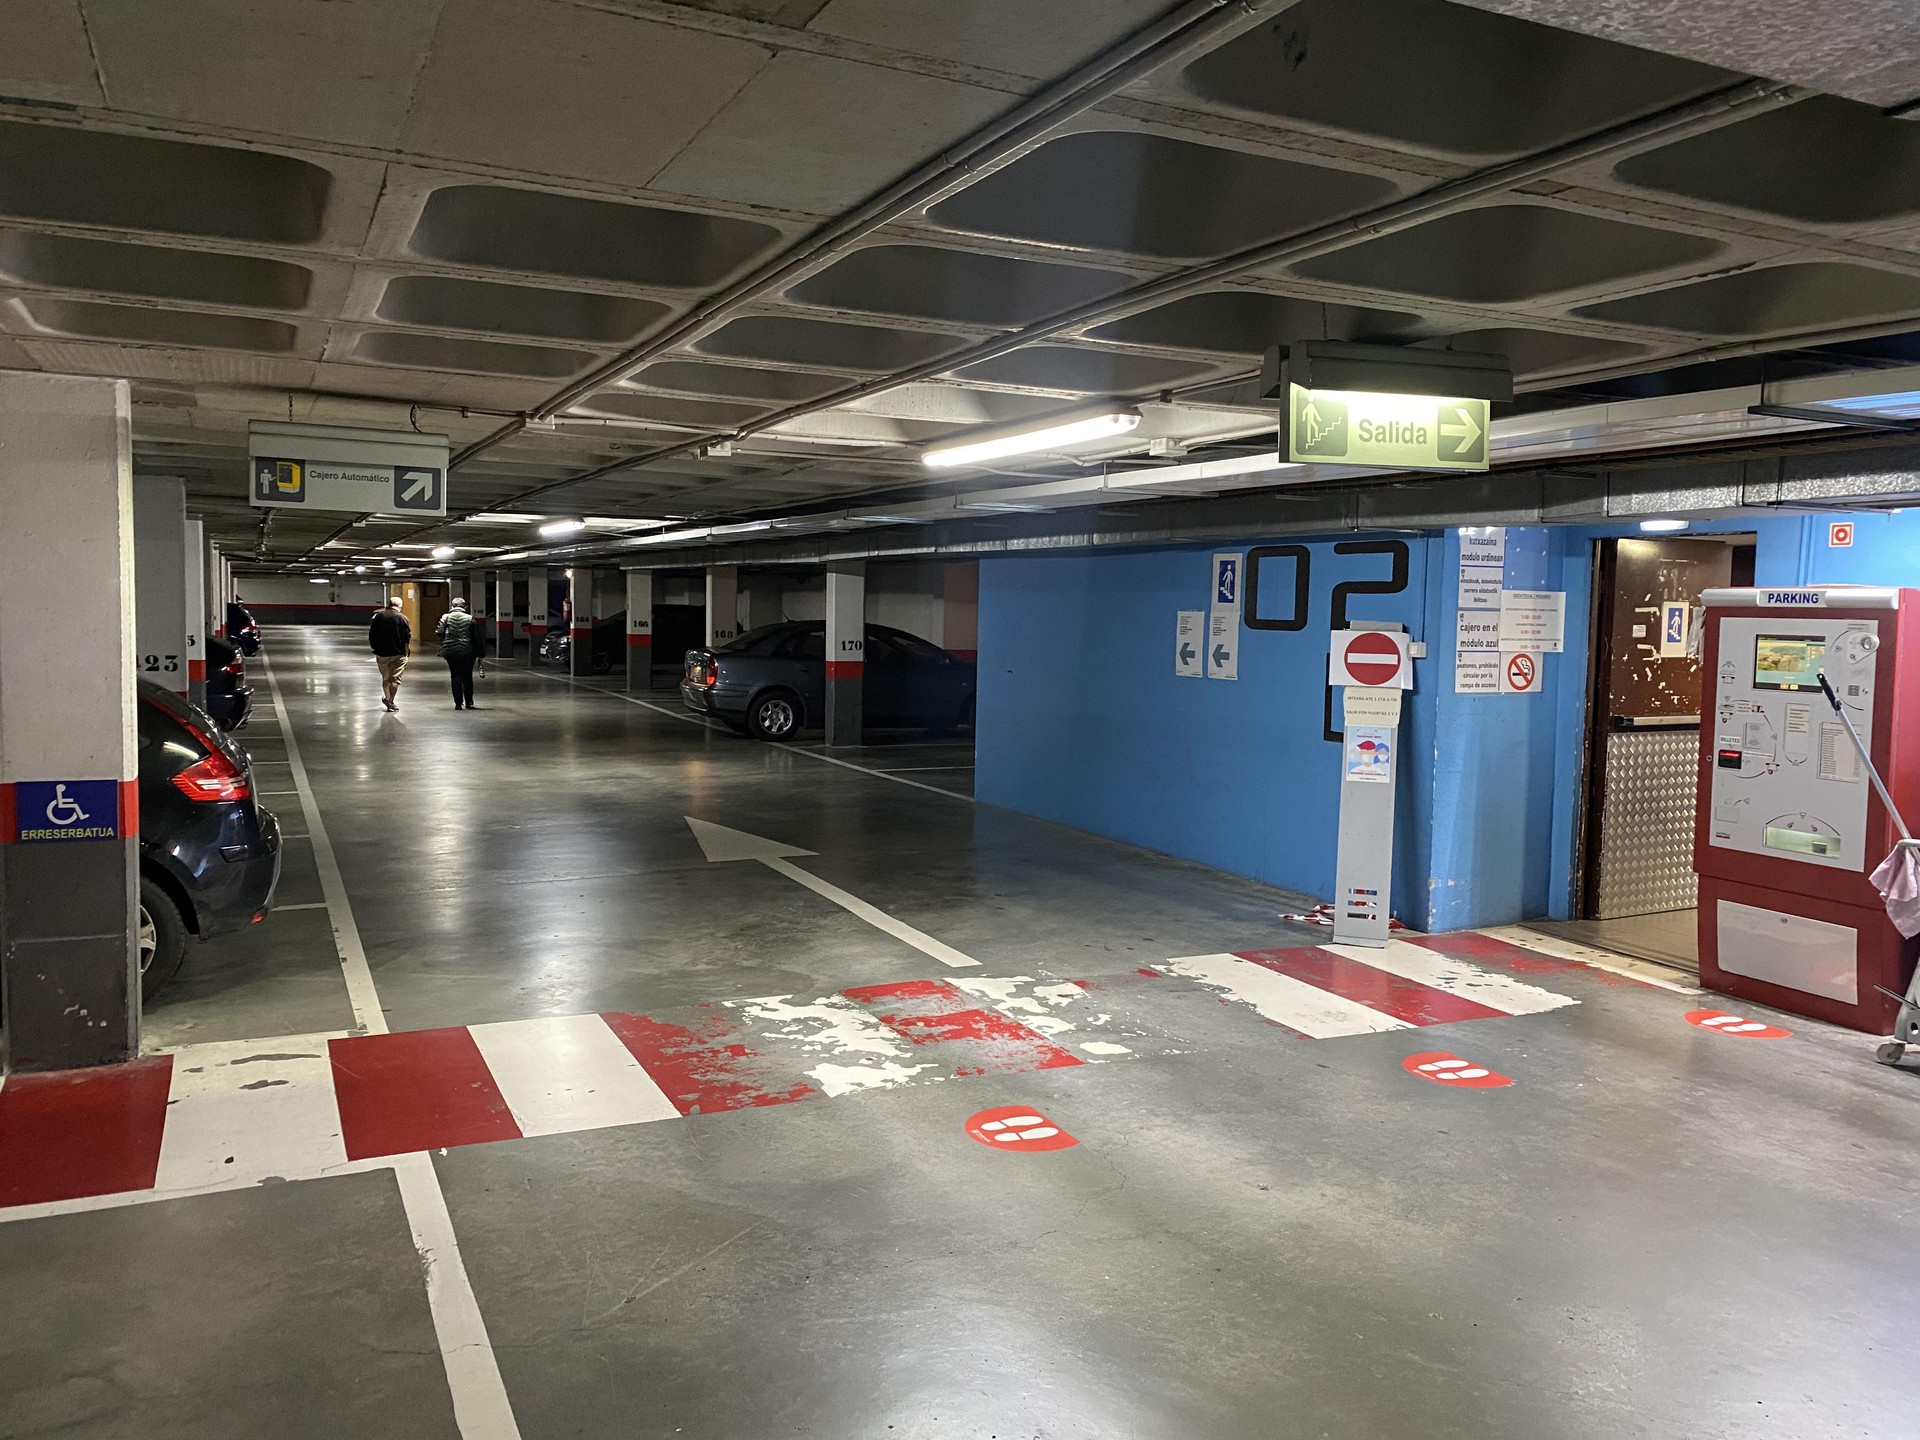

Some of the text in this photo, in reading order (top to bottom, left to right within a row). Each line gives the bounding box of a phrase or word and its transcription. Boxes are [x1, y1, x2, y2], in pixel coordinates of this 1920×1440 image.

[1358, 418, 1428, 445] Salida
[309, 470, 390, 483] Cajero Automático
[1767, 593, 1819, 604] PARKING
[633, 620, 649, 628] 166
[1460, 623, 1481, 633] cajero
[1492, 623, 1499, 632] el
[841, 640, 863, 651] 170
[1460, 639, 1499, 648] módulo azul
[21, 827, 114, 840] ERRESERBATUA
